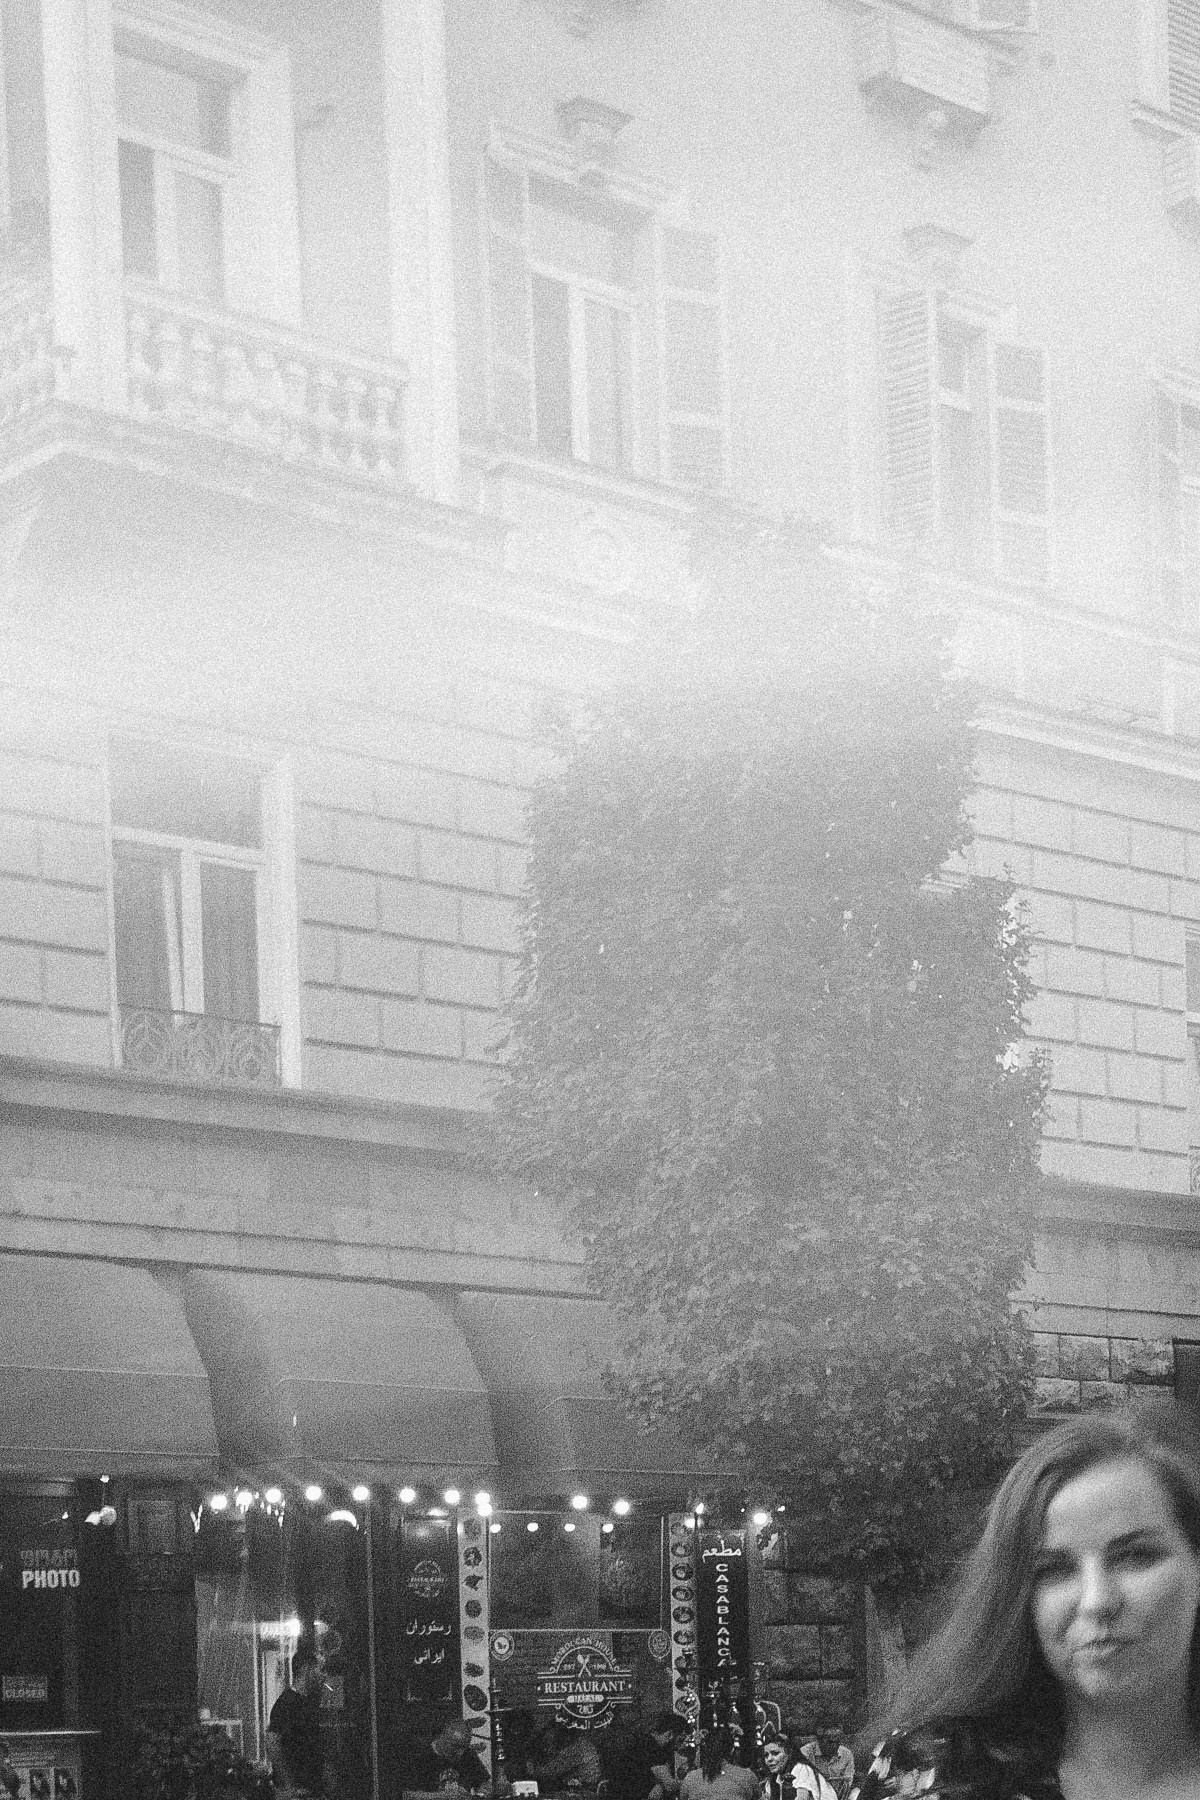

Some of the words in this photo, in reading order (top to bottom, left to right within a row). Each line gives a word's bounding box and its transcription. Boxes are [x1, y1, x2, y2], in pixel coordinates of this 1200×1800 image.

[702, 1539, 742, 1563] مطعم
[22, 1569, 81, 1589] PHOTO
[406, 1618, 452, 1636] رستوران
[544, 1680, 625, 1694] RESTAURANT
